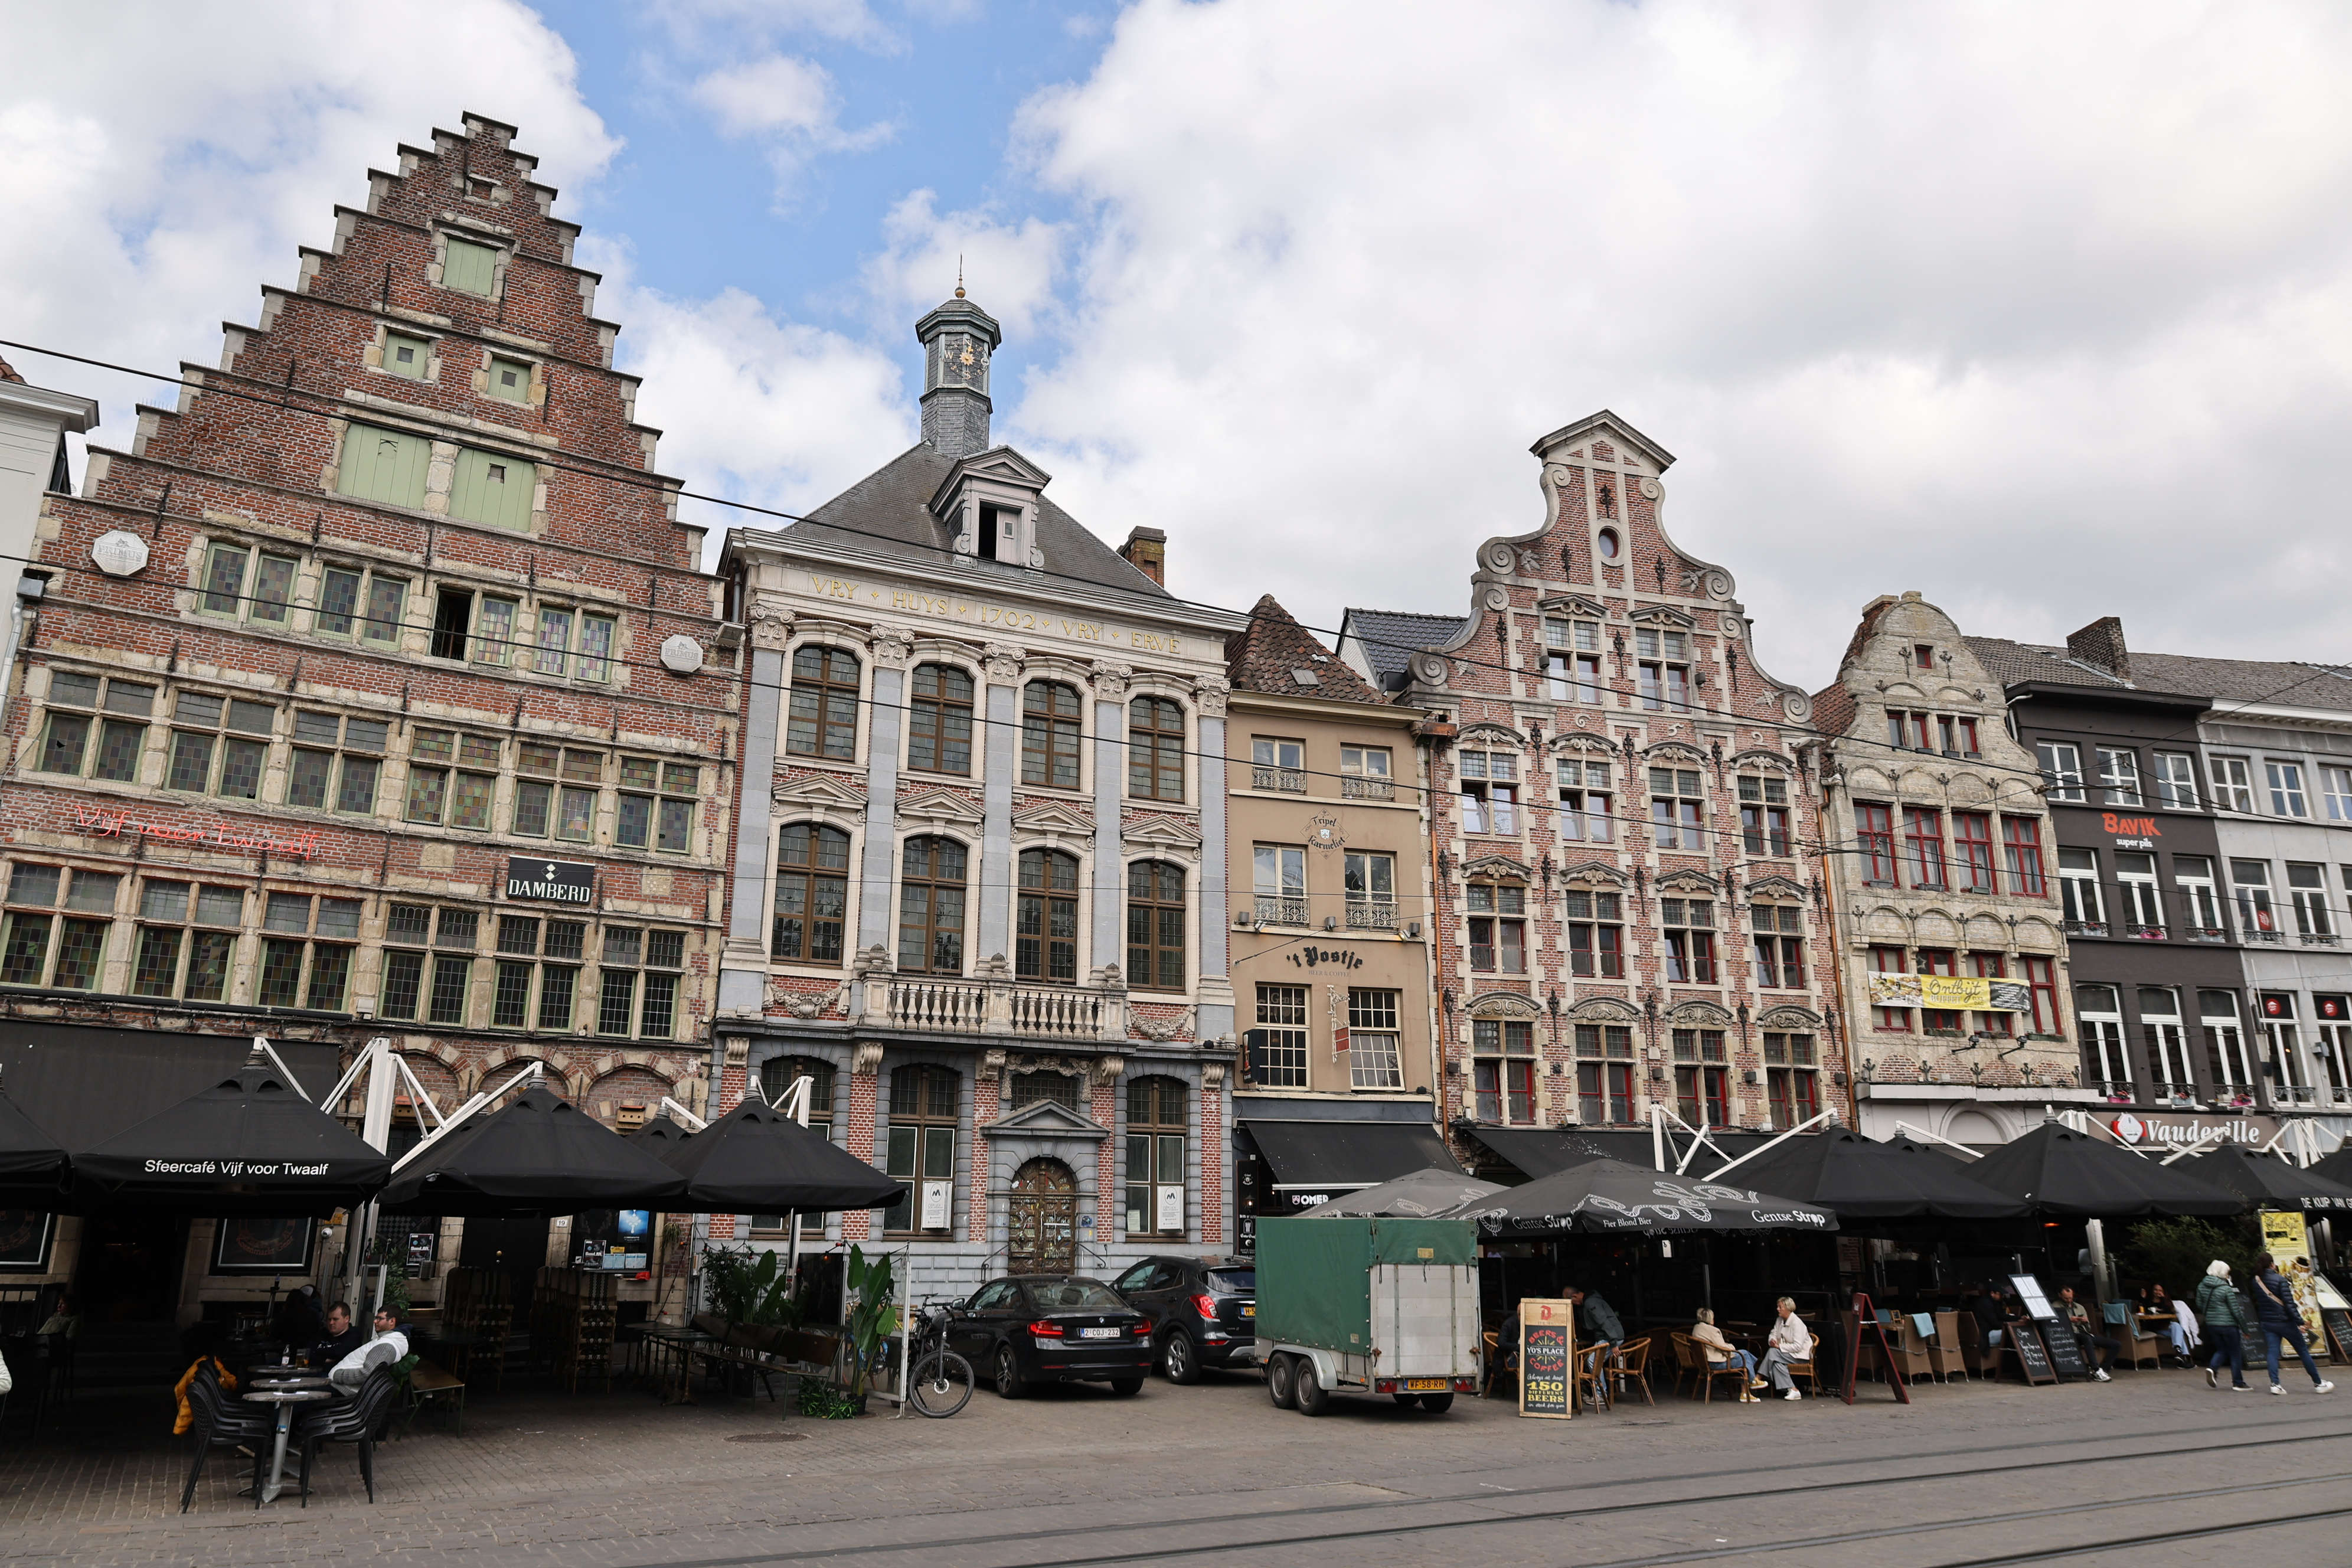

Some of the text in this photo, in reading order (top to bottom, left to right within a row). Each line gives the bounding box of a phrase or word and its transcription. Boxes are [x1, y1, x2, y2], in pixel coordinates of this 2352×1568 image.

[945, 349, 953, 360] W
[812, 576, 1181, 654] VRY HUYS 1702 VRY ERVE
[665, 647, 699, 661] PRIMUS
[75, 805, 132, 837] Vijf
[138, 824, 207, 841] voor
[1311, 815, 1337, 827] Tripel
[2102, 812, 2162, 836] BAVIK
[1308, 834, 1346, 850] Karmeliet
[2116, 837, 2153, 849] super pils
[508, 878, 590, 903] DAMBERD
[1304, 946, 1363, 969] Postje
[145, 1159, 329, 1177] Sfeercafé Vijf voor Twaalf
[2301, 1197, 2314, 1208] DE
[2312, 1197, 2331, 1208] KUIP
[2331, 1197, 2346, 1208] VAN
[1512, 1214, 1573, 1231] Gentse Strop
[1603, 1219, 1616, 1228] Fier
[1617, 1218, 1638, 1227] Blond
[1751, 1210, 1825, 1227] Gentse Strop
[1528, 1329, 1557, 1344] BEERS
[1530, 1358, 1564, 1372] COFFEE
[1410, 1379, 1444, 1389] WF-58-RH
[1527, 1381, 1564, 1391] 150
[1527, 1394, 1564, 1403] BEERS
